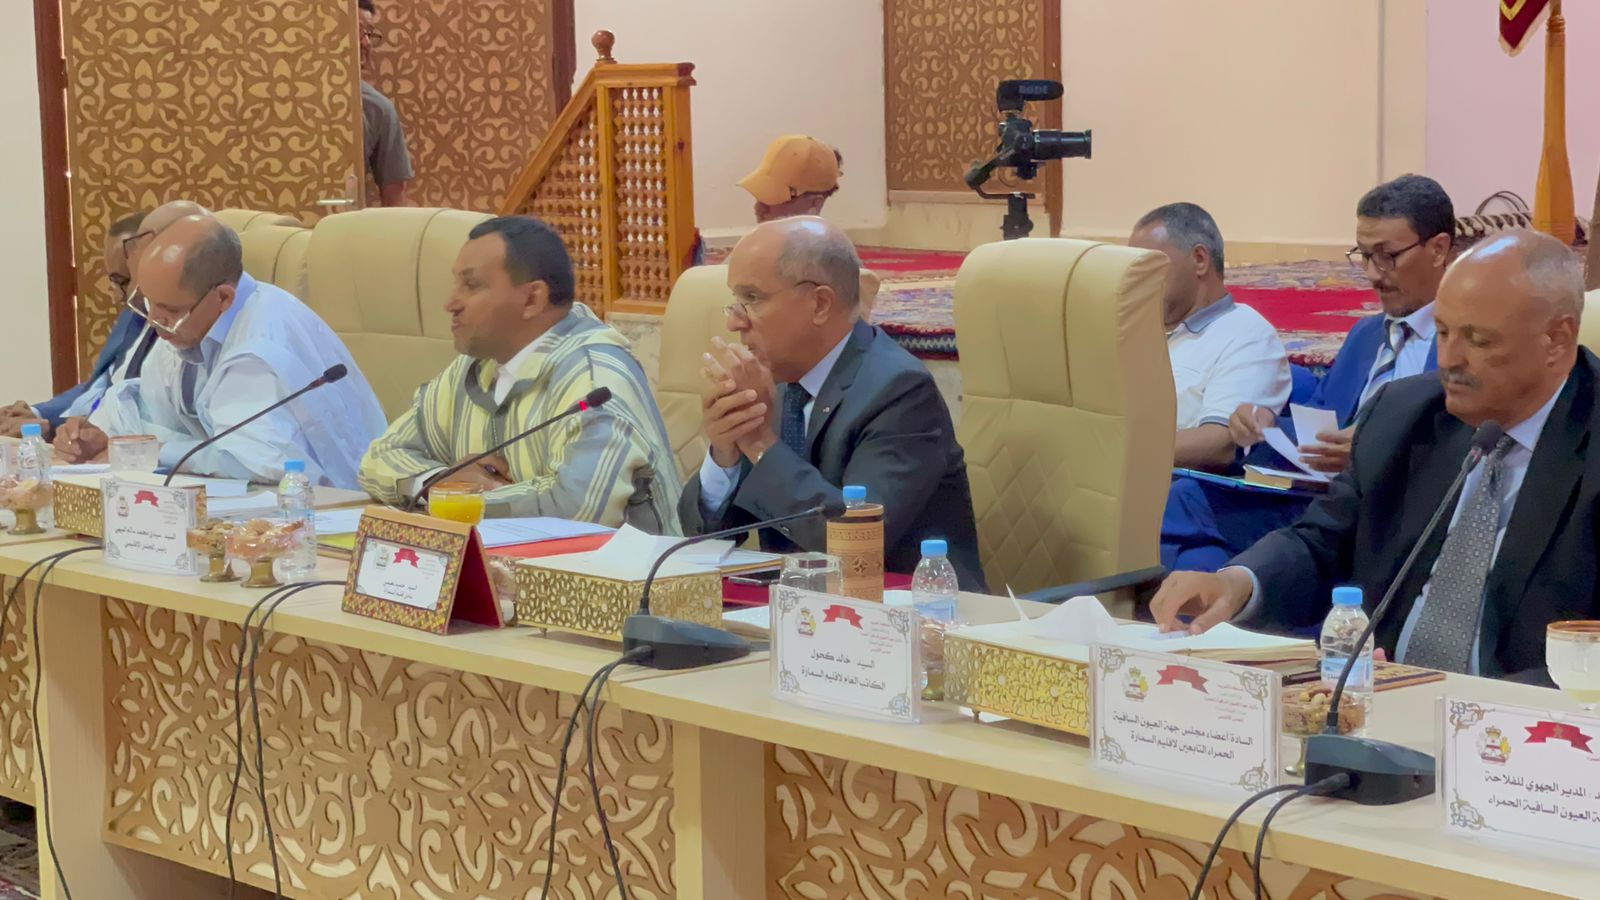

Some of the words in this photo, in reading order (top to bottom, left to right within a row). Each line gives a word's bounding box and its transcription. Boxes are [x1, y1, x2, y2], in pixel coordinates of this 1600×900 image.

[810, 648, 835, 661] كحول
[1484, 770, 1524, 787] للفلاحة
[1525, 781, 1559, 793] الجهوي
[1560, 787, 1586, 799] المدير
[1488, 794, 1522, 808] الحمراء
[1522, 799, 1558, 815] الساقية
[1560, 809, 1591, 822] العيون
